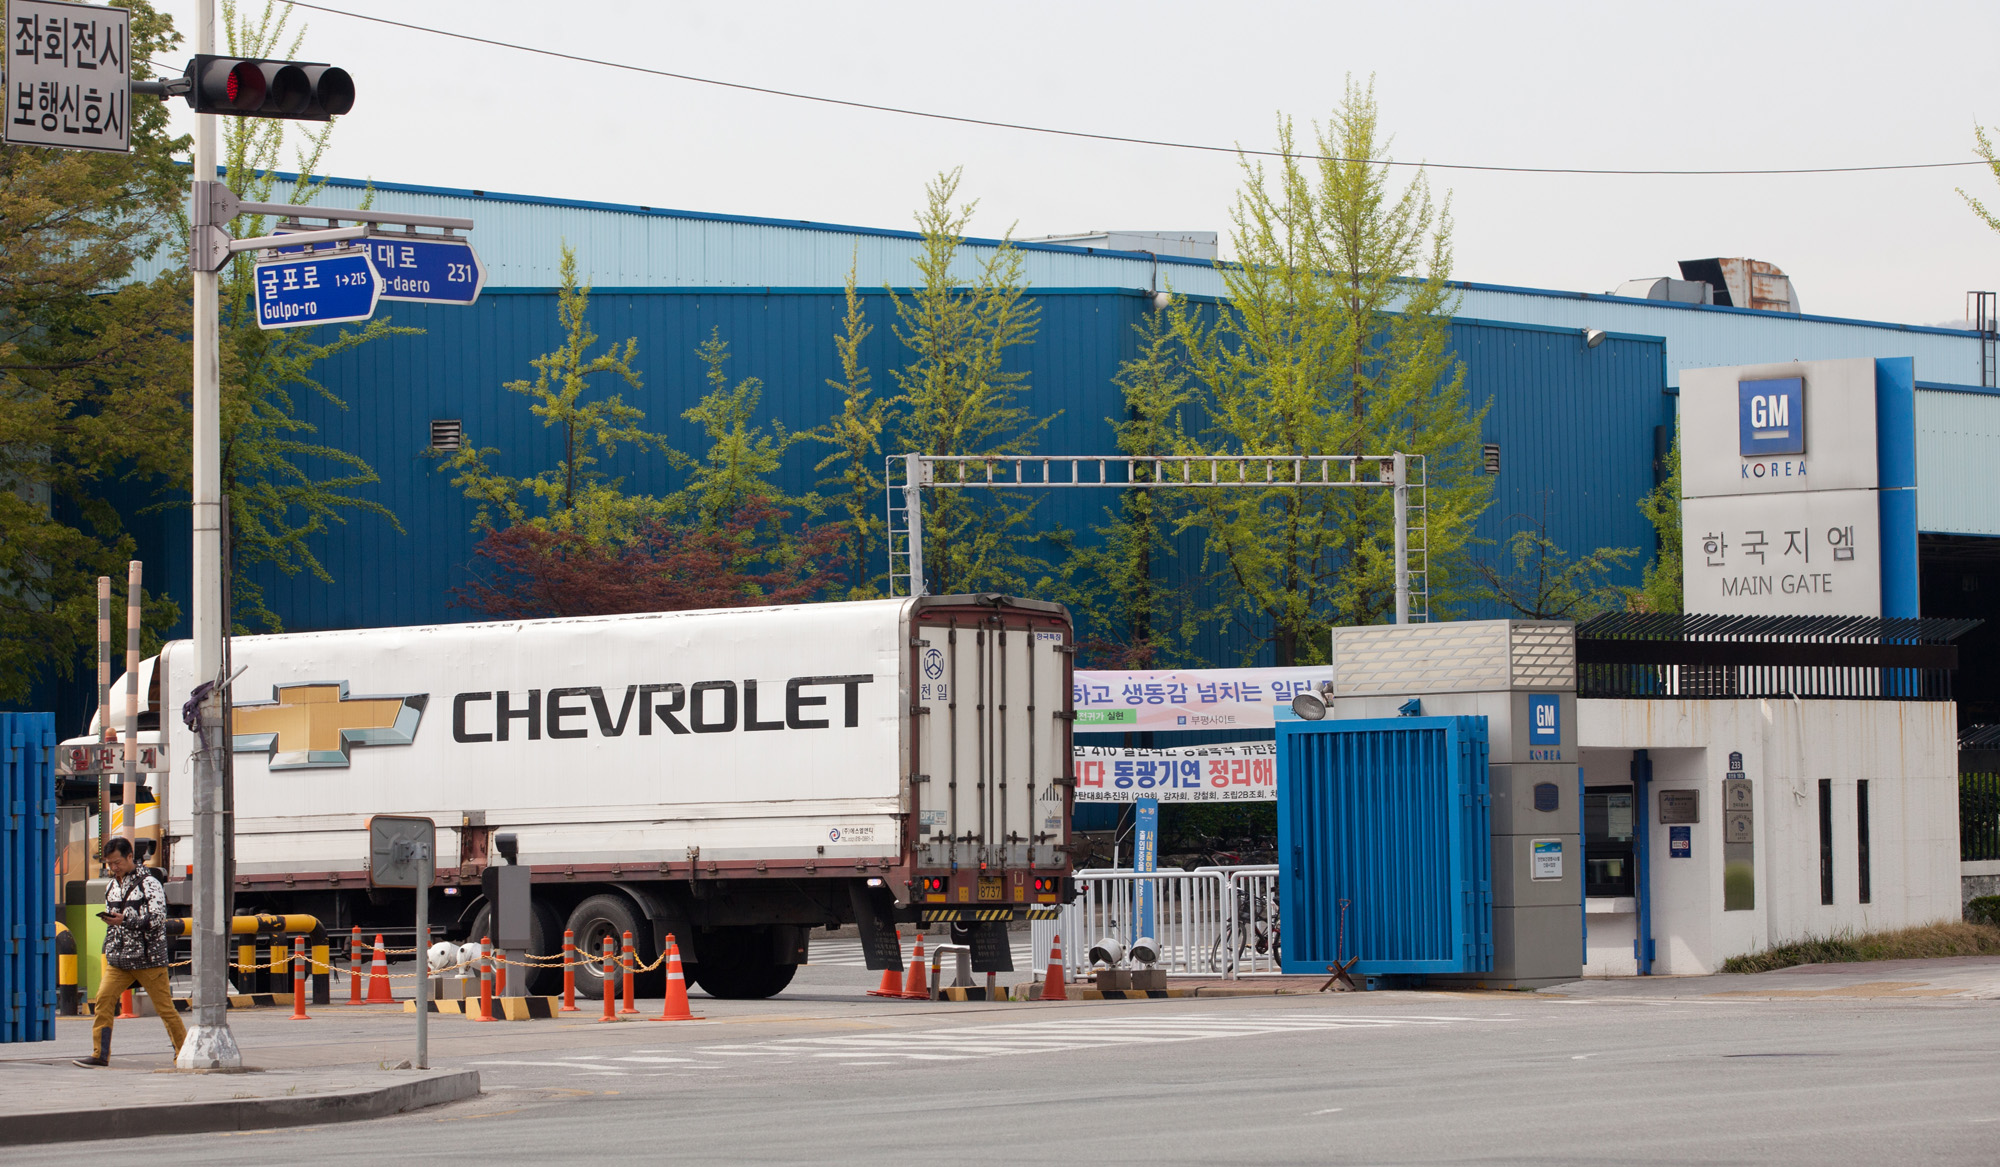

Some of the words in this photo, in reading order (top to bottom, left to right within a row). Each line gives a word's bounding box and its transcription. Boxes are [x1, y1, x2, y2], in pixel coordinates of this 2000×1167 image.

[16, 14, 123, 74] 좌회전시
[14, 82, 124, 140] 보행신호시
[262, 266, 320, 300] 굴포로
[447, 263, 472, 283] 231
[264, 302, 317, 320] Gulpo-ro
[1751, 394, 1789, 429] GM
[1741, 461, 1807, 479] KOREA
[1702, 526, 1855, 568] 한국지엠
[1722, 576, 1772, 596] MAIN
[1781, 573, 1832, 595] GATE
[1122, 682, 1188, 705] 생동감
[1197, 682, 1262, 703] 넘치는
[453, 674, 874, 743] CHEVROLET
[1074, 712, 1104, 722] 전귀가
[1107, 711, 1124, 721] 실현
[1536, 705, 1555, 727] GM
[1191, 715, 1236, 726] 부평사이트
[71, 747, 157, 772] 일단지
[1530, 750, 1561, 761] KOREA
[1731, 761, 1741, 769] 233
[1114, 760, 1200, 789] 동광기연
[980, 886, 1001, 898] 8737
